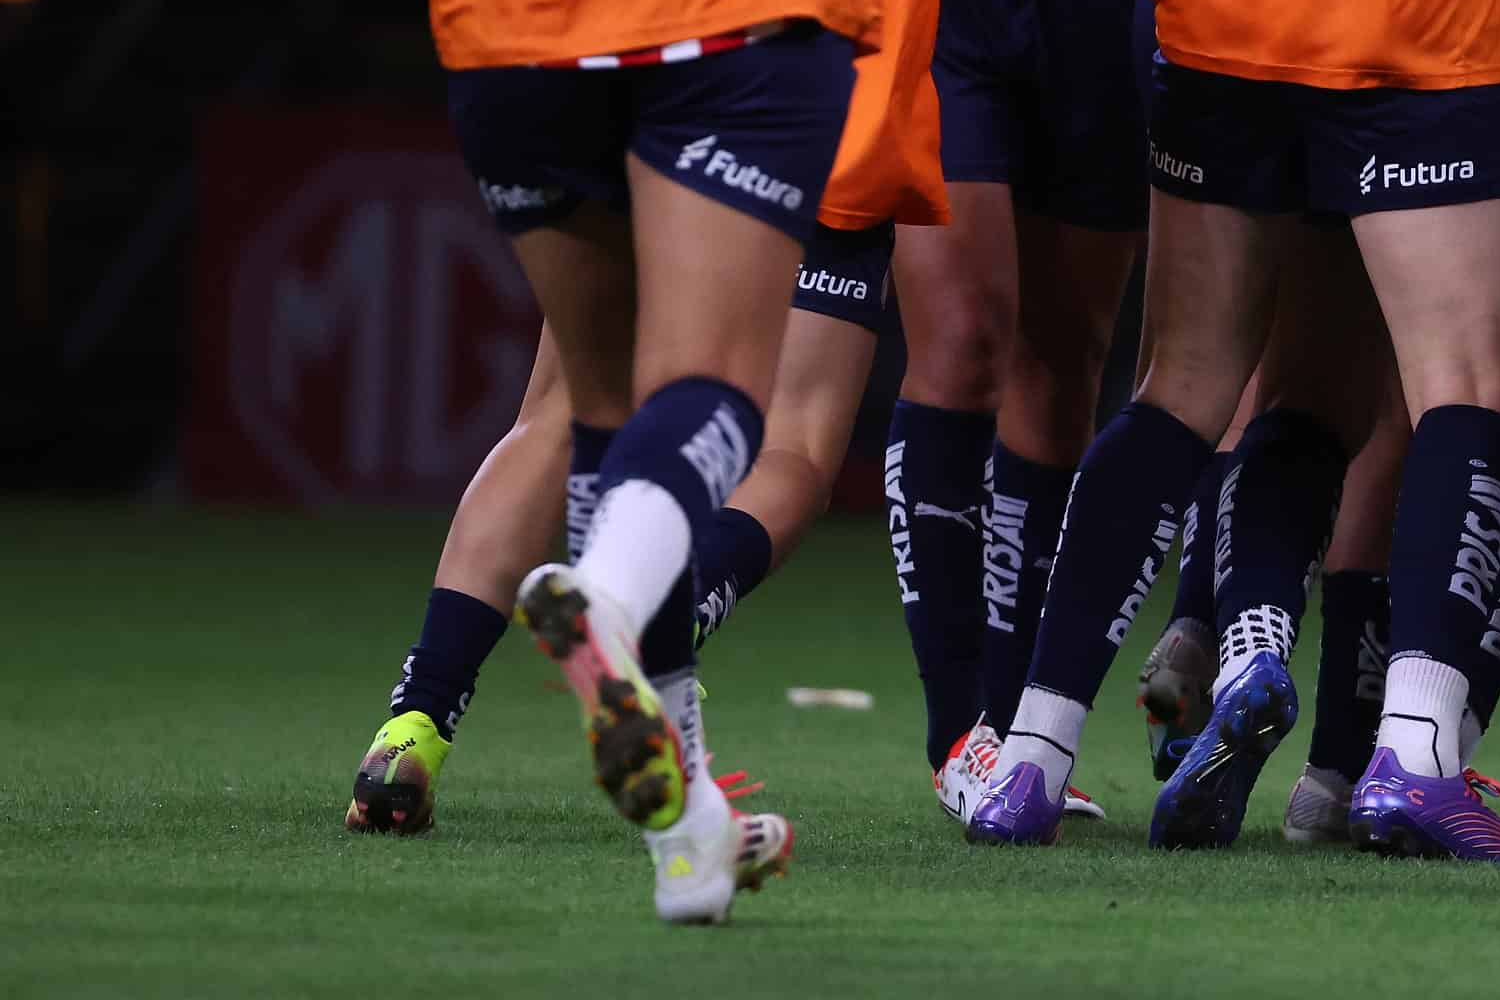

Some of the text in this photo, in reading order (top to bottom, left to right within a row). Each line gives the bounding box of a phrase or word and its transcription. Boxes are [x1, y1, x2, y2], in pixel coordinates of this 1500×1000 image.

[704, 149, 803, 211] Futura
[1383, 160, 1475, 189] Futura
[797, 263, 869, 301] utura
